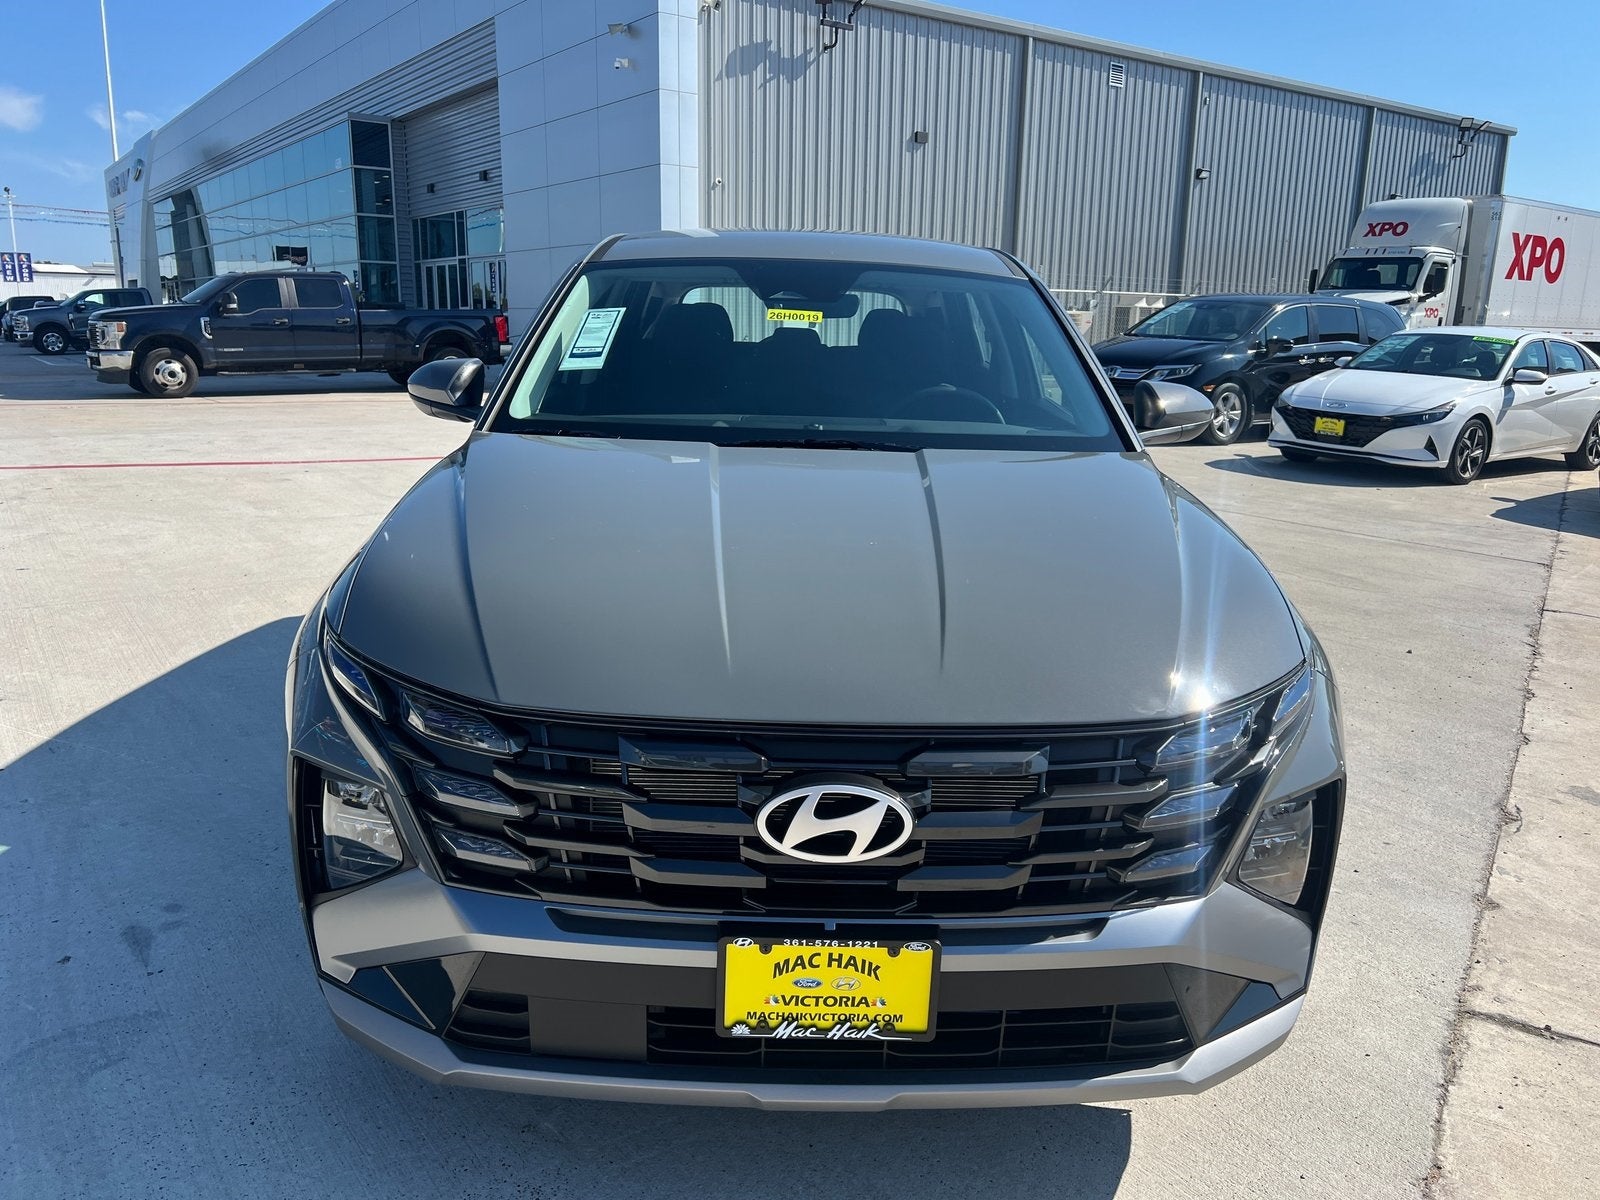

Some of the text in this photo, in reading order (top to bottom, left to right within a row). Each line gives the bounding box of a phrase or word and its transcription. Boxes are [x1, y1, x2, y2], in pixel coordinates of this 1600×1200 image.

[1362, 222, 1409, 237] XPO
[1504, 232, 1565, 284] XPO
[5, 264, 14, 282] NEW
[22, 264, 30, 282] FORD
[769, 311, 819, 321] 26H0019
[1424, 307, 1439, 318] XPO
[783, 938, 879, 948] 361-576-1221
[772, 952, 881, 981] MAC HAIK
[780, 995, 870, 1008] VICTORIA
[746, 1011, 903, 1023] MACHAIKVICTORIA.COM
[772, 1021, 880, 1040] Mac Haik
